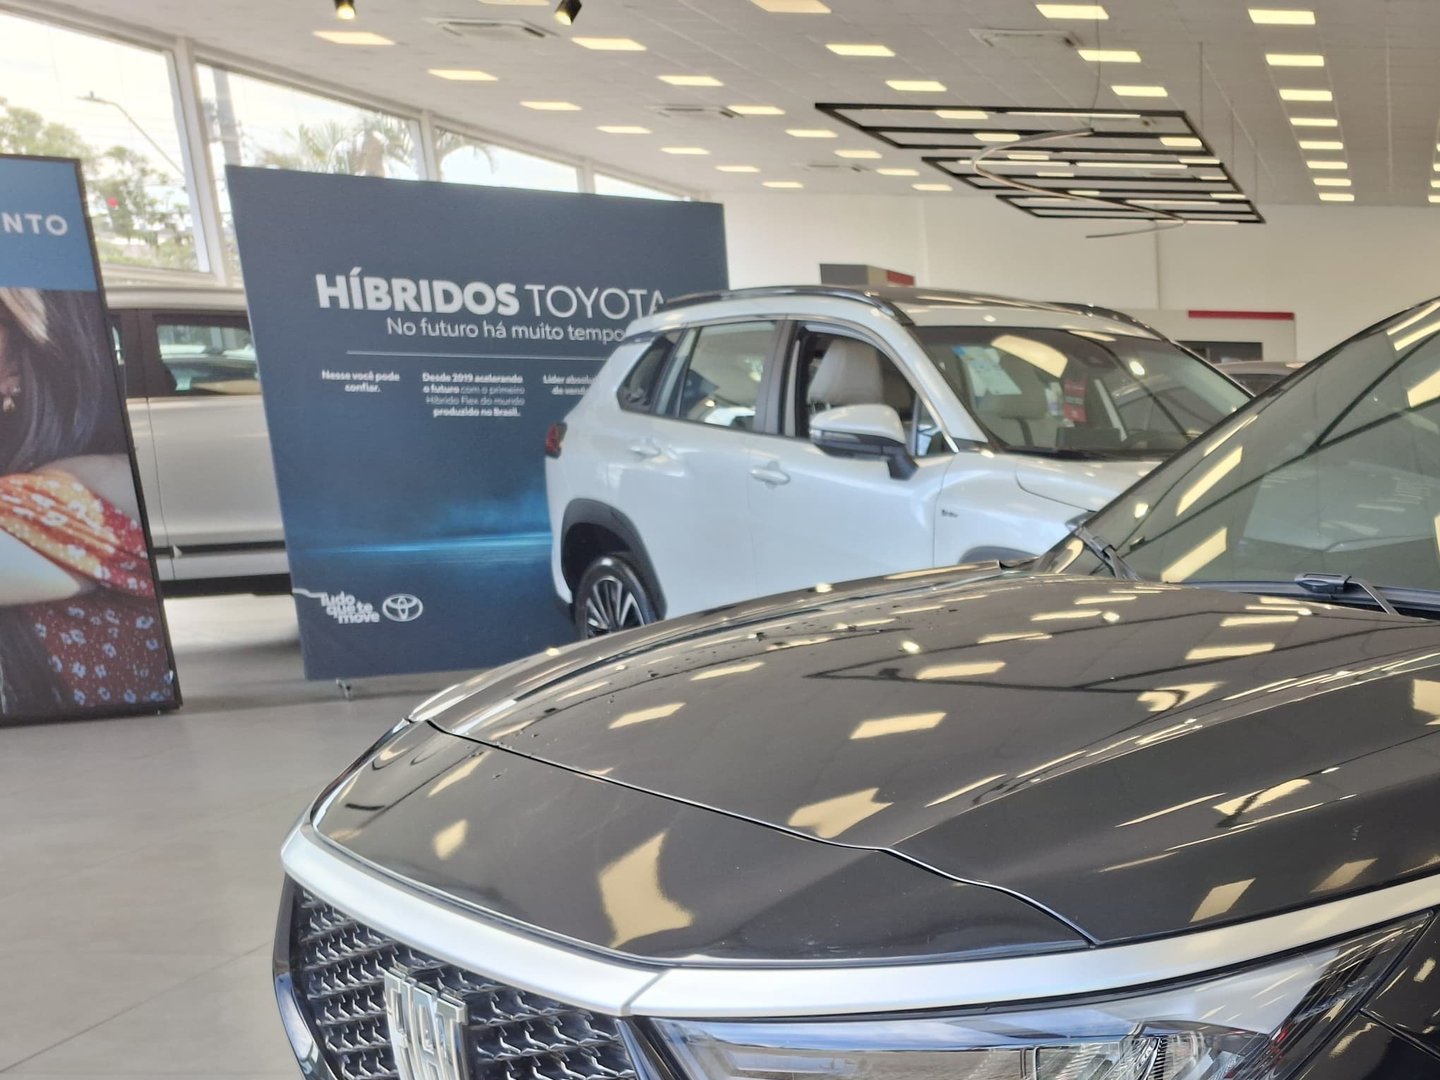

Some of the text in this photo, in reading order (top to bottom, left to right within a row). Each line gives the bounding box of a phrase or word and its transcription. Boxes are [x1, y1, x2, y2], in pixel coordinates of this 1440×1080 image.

[0, 211, 69, 237] NTO
[315, 266, 665, 320] HÍBRIDOS TOYOTA
[386, 317, 625, 345] No futuro há muito tempo
[375, 371, 401, 383] pode
[422, 371, 451, 383] Desde
[452, 372, 474, 383] 2019
[430, 383, 460, 394] futuro
[433, 406, 480, 418] produzido
[338, 611, 380, 625] move
